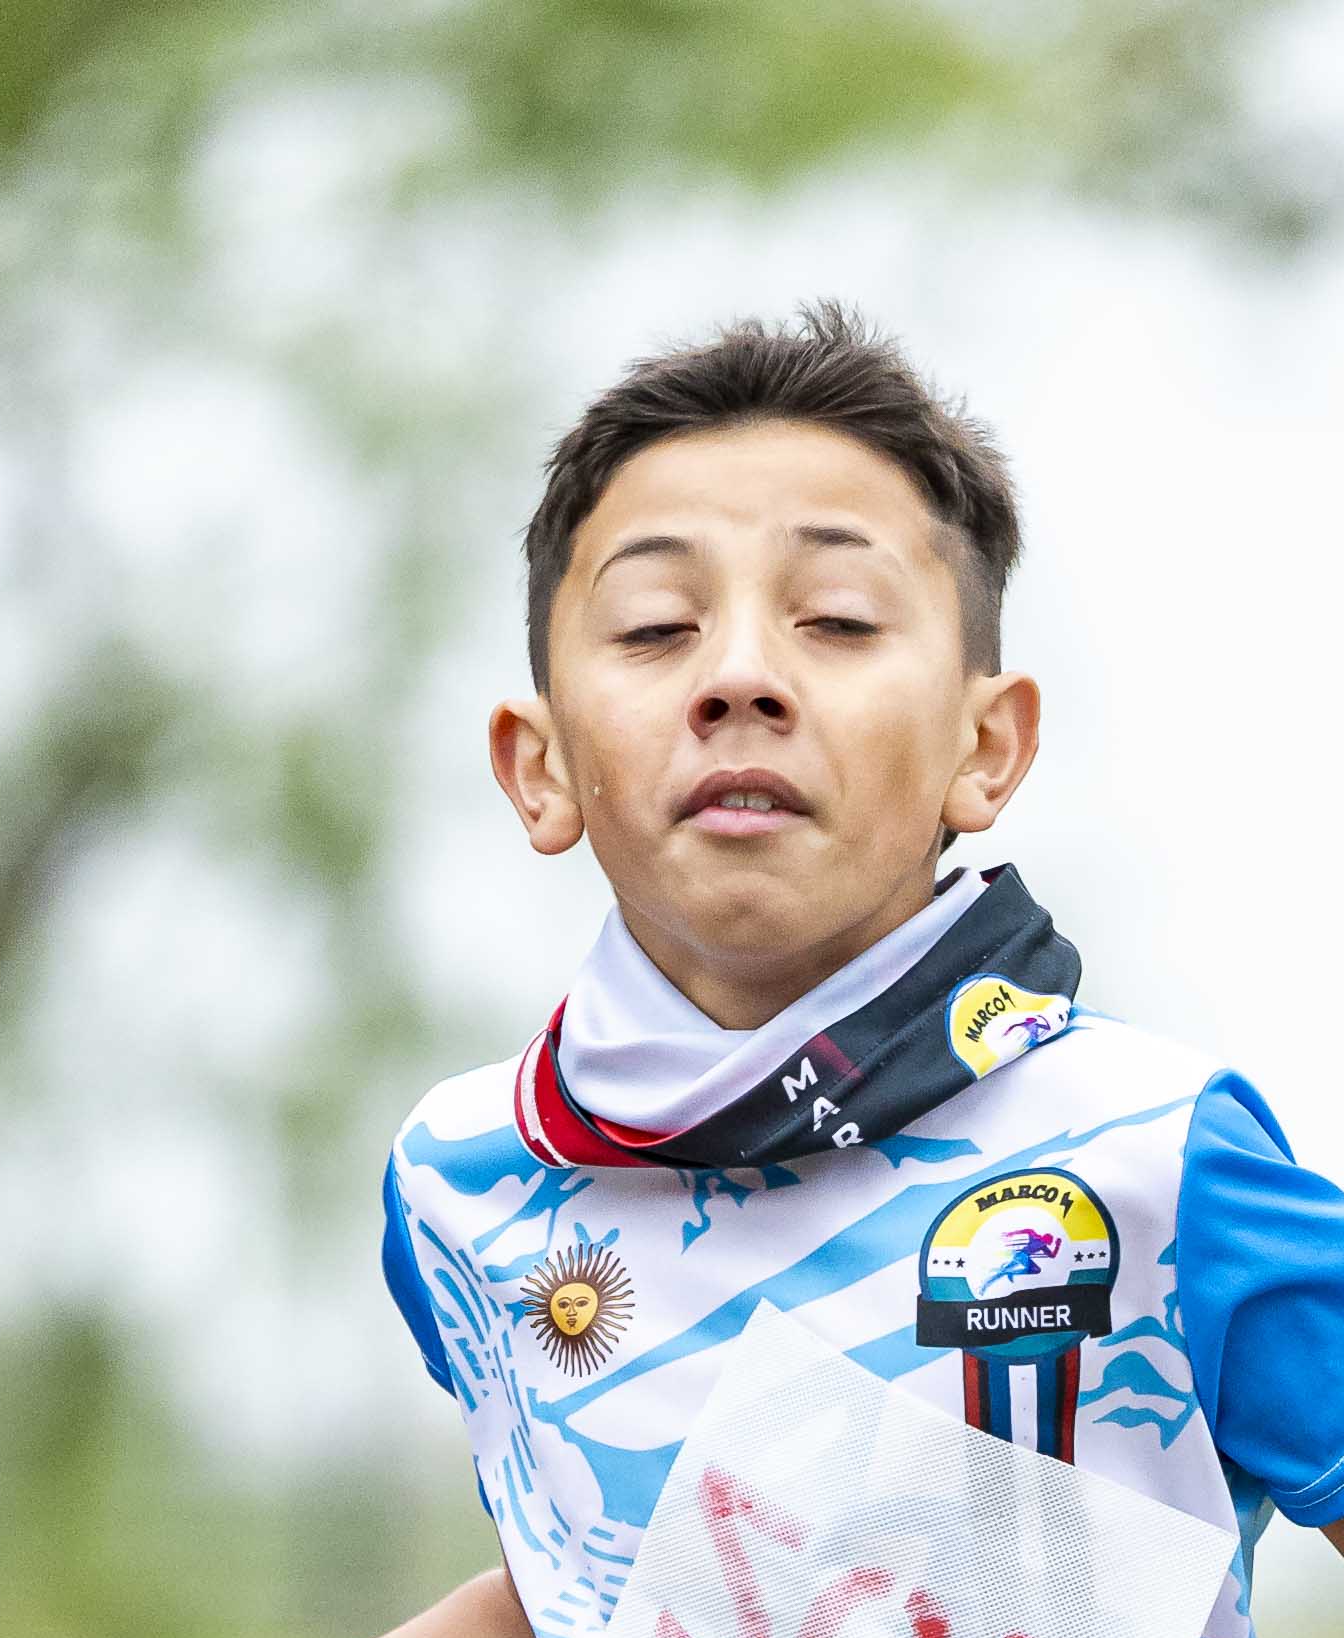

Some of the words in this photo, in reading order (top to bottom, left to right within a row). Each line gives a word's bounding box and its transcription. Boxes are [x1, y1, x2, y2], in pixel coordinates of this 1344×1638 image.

[965, 995, 1006, 1043] MARCO
[975, 1184, 1059, 1213] MARCO
[967, 1304, 1072, 1331] RUNNER
